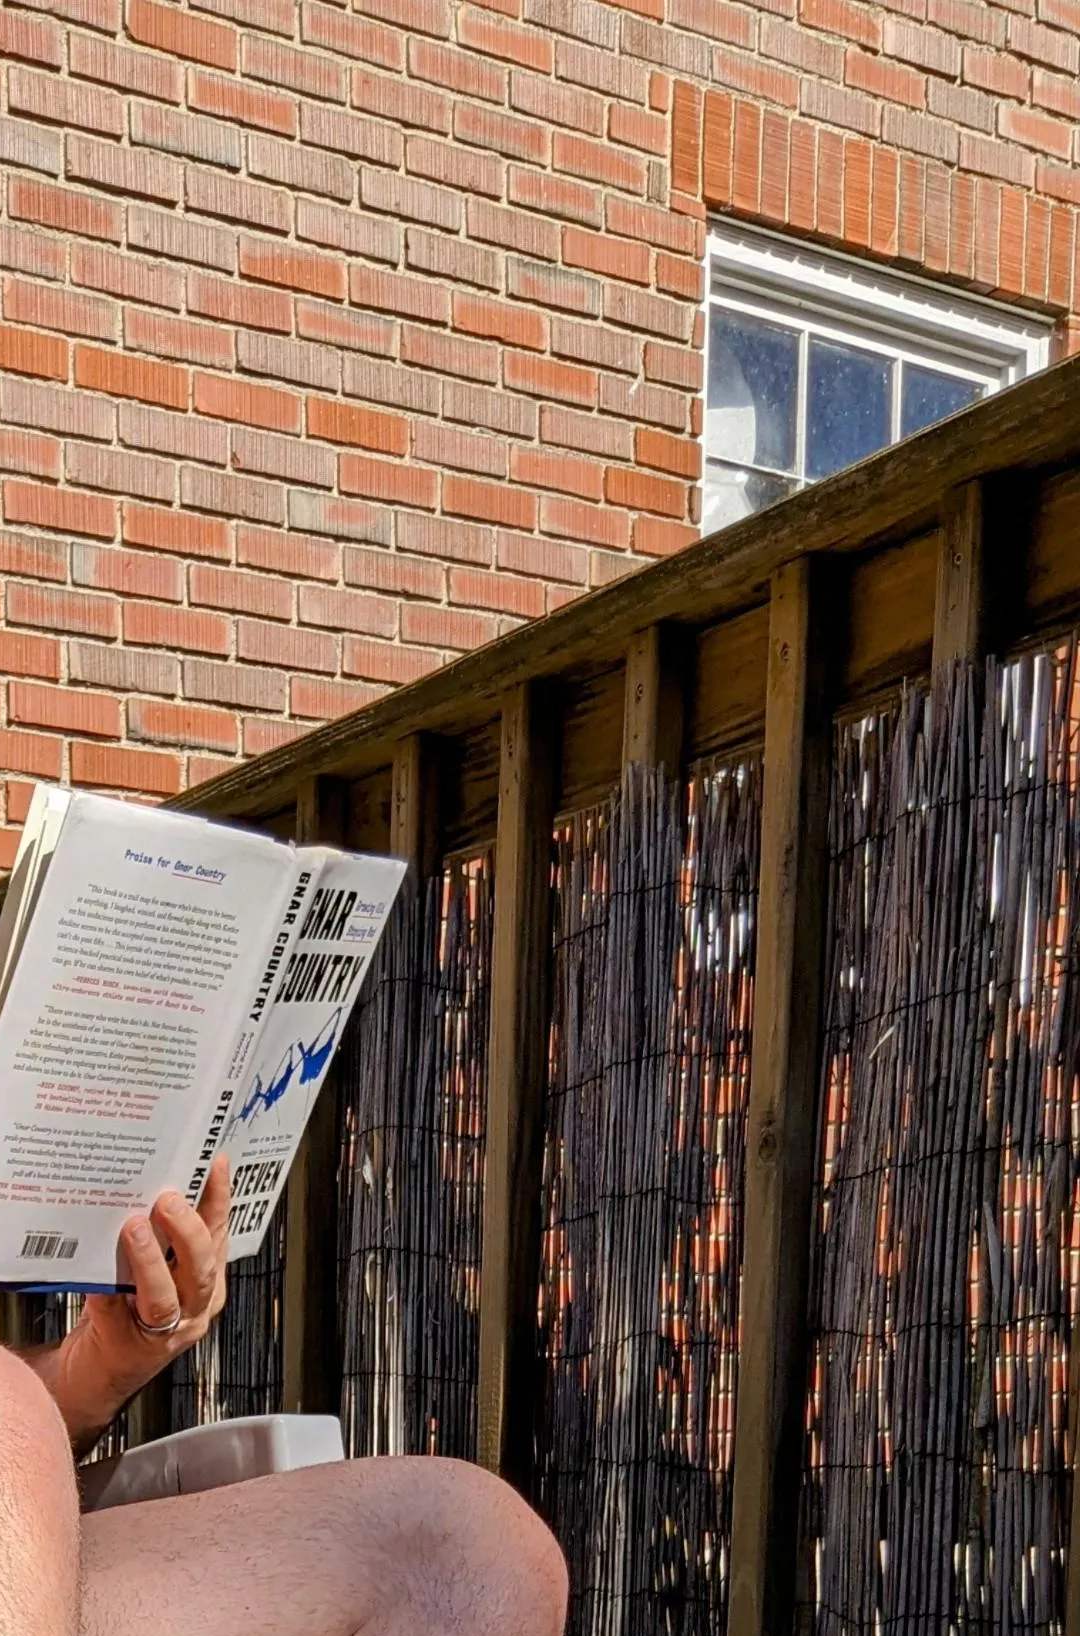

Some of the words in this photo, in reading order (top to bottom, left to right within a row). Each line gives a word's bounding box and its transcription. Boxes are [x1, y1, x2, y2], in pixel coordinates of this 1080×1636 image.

[124, 849, 153, 865] Praise
[157, 856, 170, 868] for
[174, 860, 193, 873] Gnar
[195, 865, 227, 881] Country
[283, 872, 311, 926] GNAR
[299, 887, 358, 941] GNAR
[249, 932, 289, 1022] COUNTRY
[273, 952, 366, 1004] COUNTRY
[199, 1089, 234, 1162] STEVEN
[230, 1159, 287, 1199] STEVEN
[228, 1199, 271, 1238] OTLER
